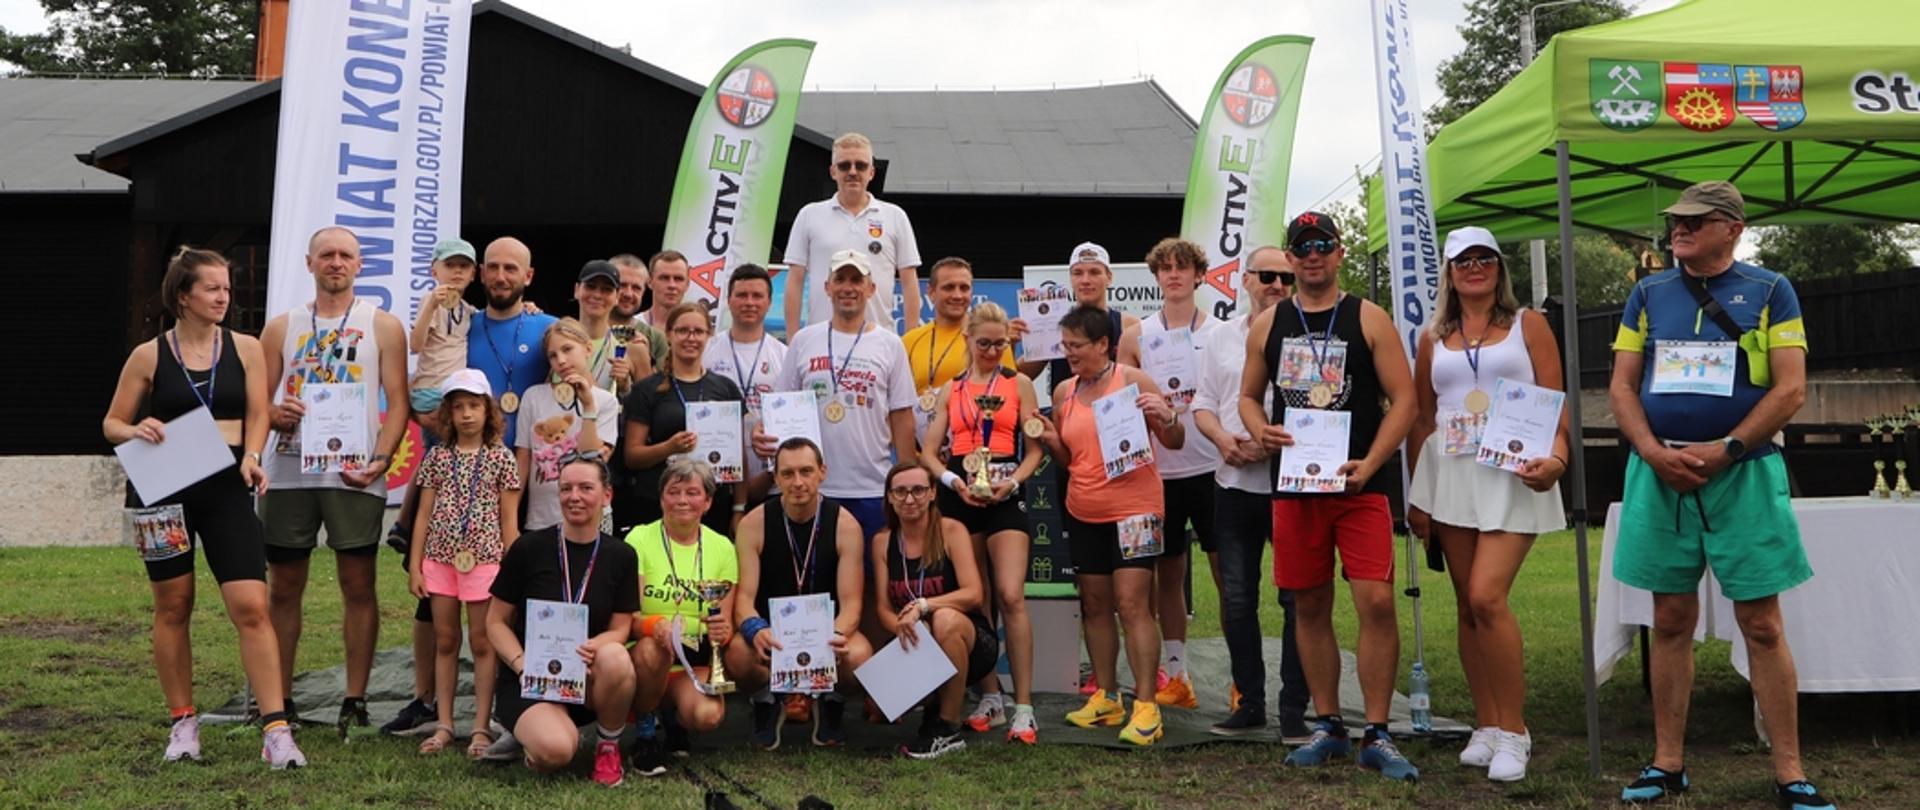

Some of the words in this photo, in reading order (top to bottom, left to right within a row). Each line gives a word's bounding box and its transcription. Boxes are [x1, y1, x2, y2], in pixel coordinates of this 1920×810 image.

[1855, 75, 1920, 112] St
[1297, 211, 1319, 227] NY
[1106, 286, 1165, 301] TOWNI
